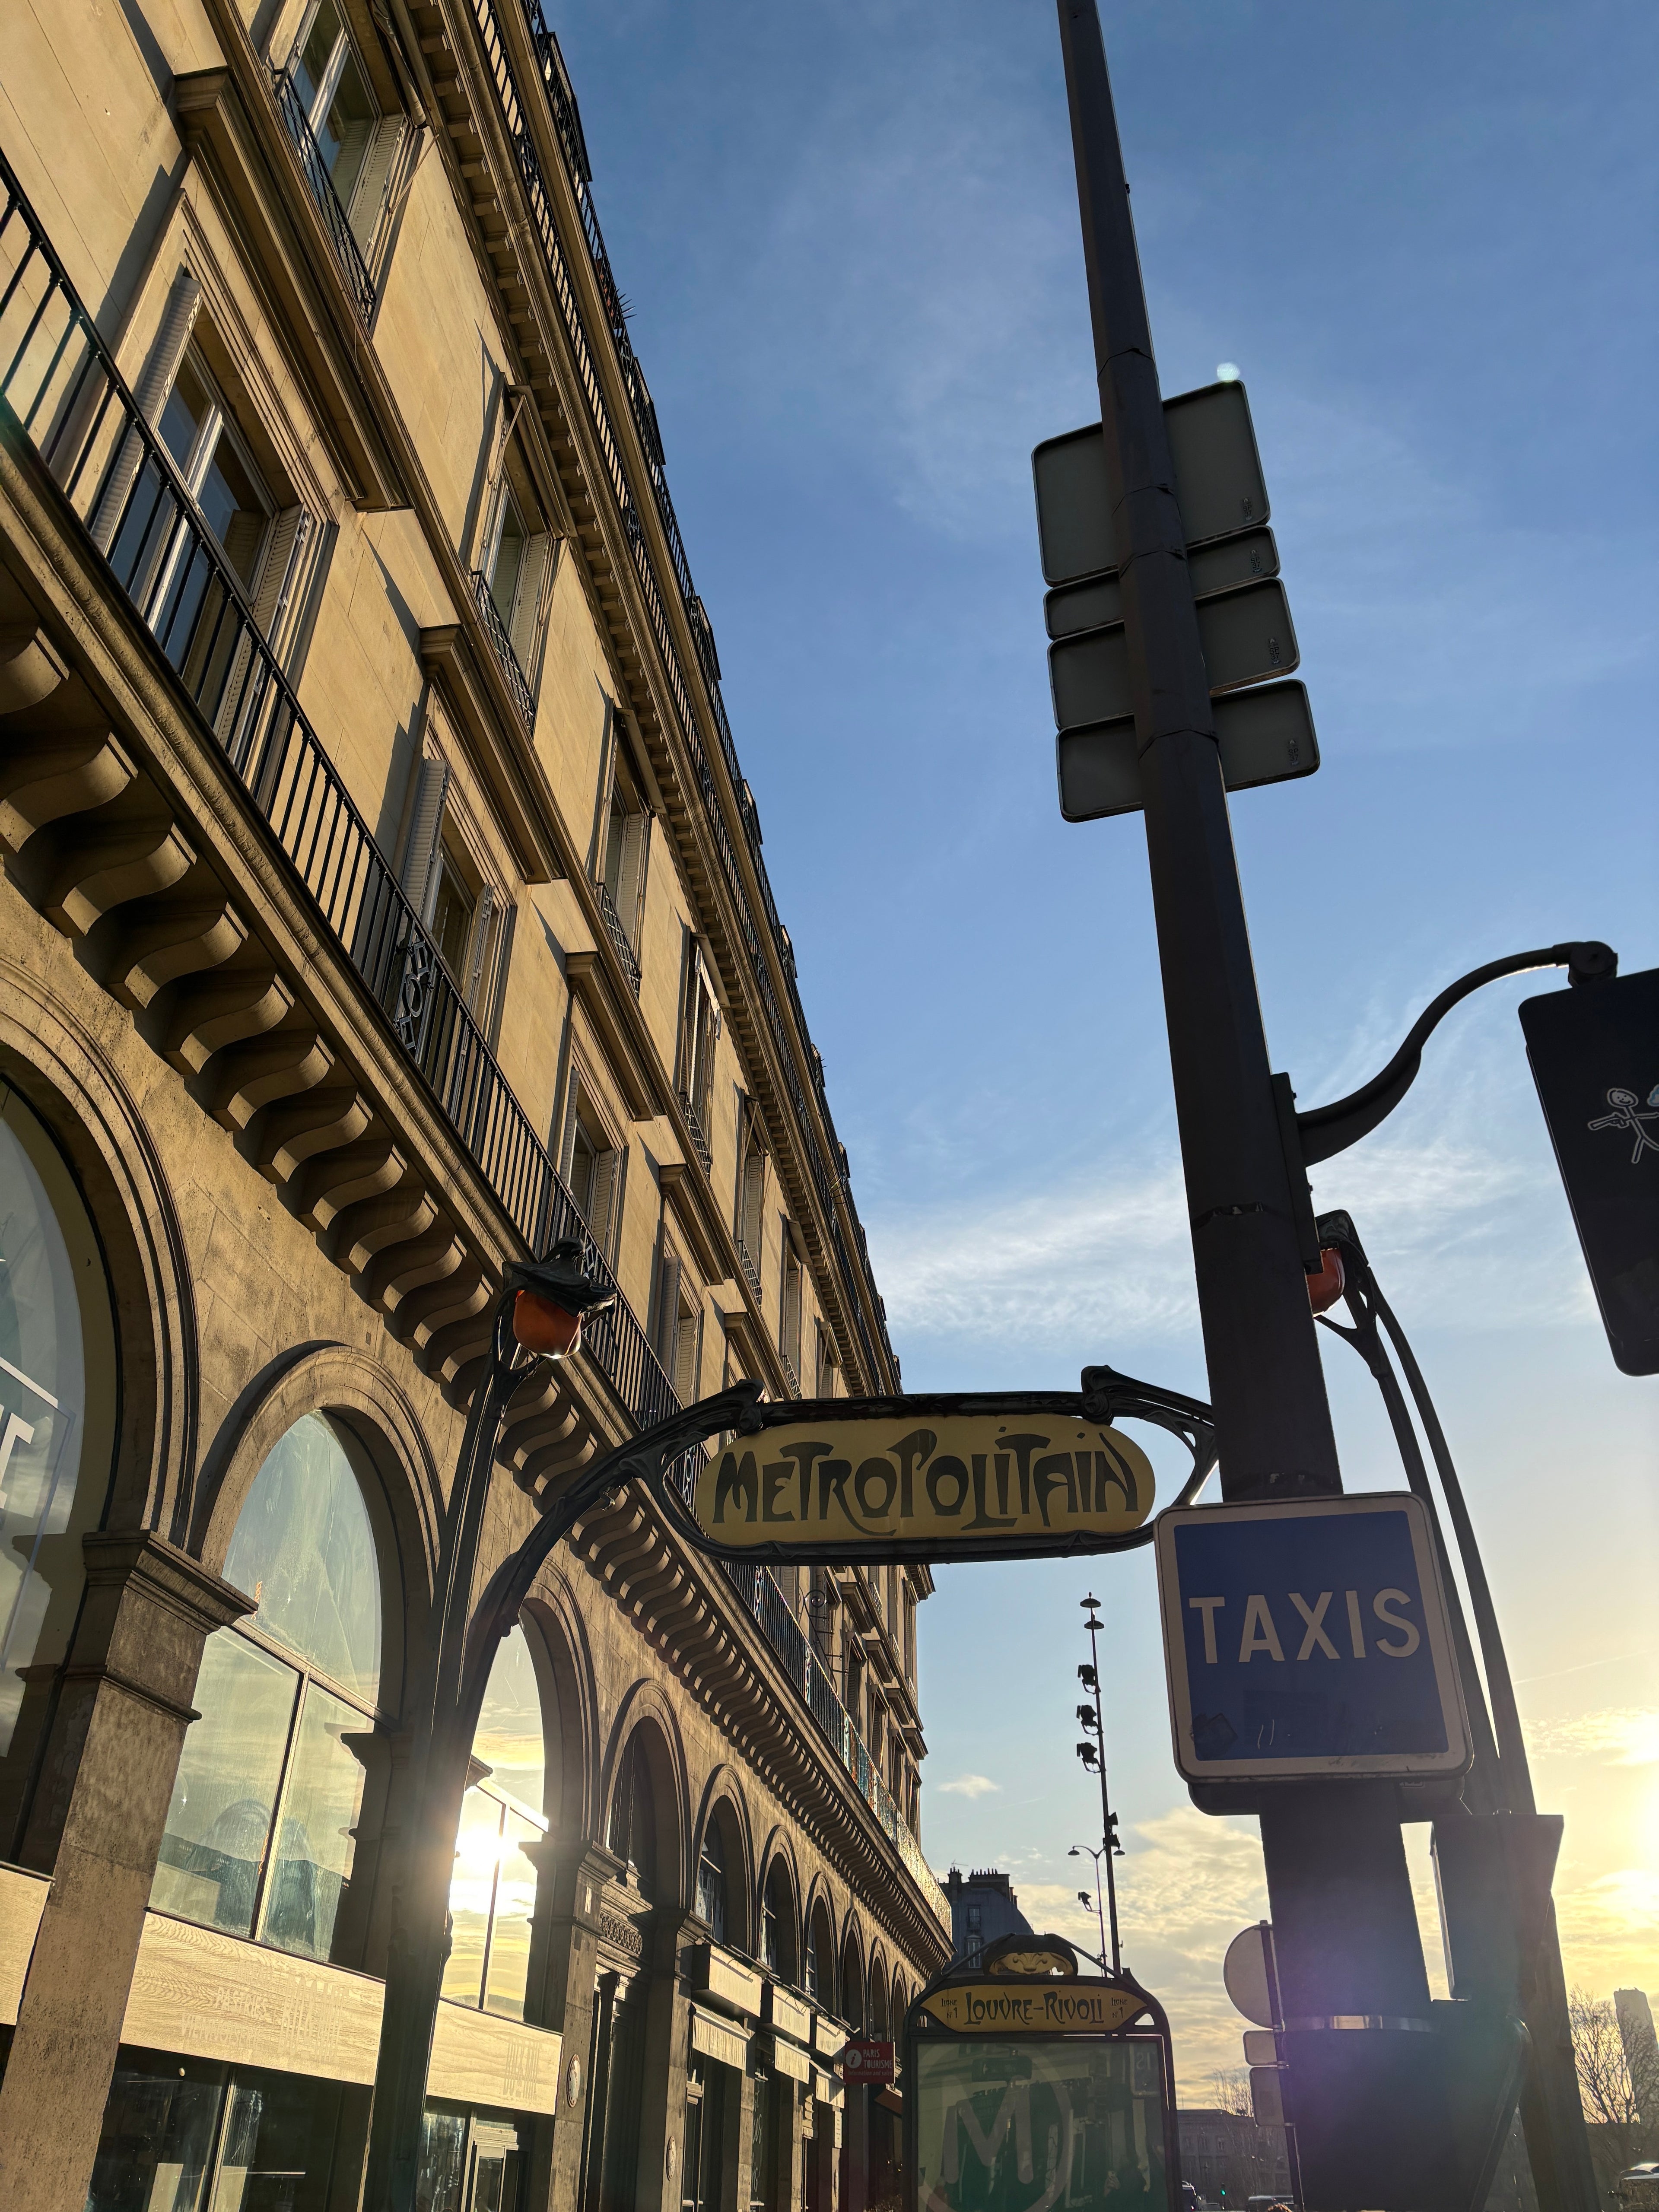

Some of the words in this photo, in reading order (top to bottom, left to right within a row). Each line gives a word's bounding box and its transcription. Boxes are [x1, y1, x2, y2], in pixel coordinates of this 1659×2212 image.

[712, 1426, 1138, 1536] METROPOLITAIN
[1189, 1588, 1421, 1664] TAXIS
[215, 1986, 268, 2020] PASTRIES
[941, 1998, 958, 2007] LIGNE
[1111, 1997, 1128, 2006] LIGNE
[953, 2007, 958, 2018] 1
[964, 1990, 1104, 2025] LOUVRE-RIVOLI
[1119, 2006, 1123, 2018] 1
[863, 2049, 880, 2058] PARIS
[864, 2059, 893, 2069] TOURISME
